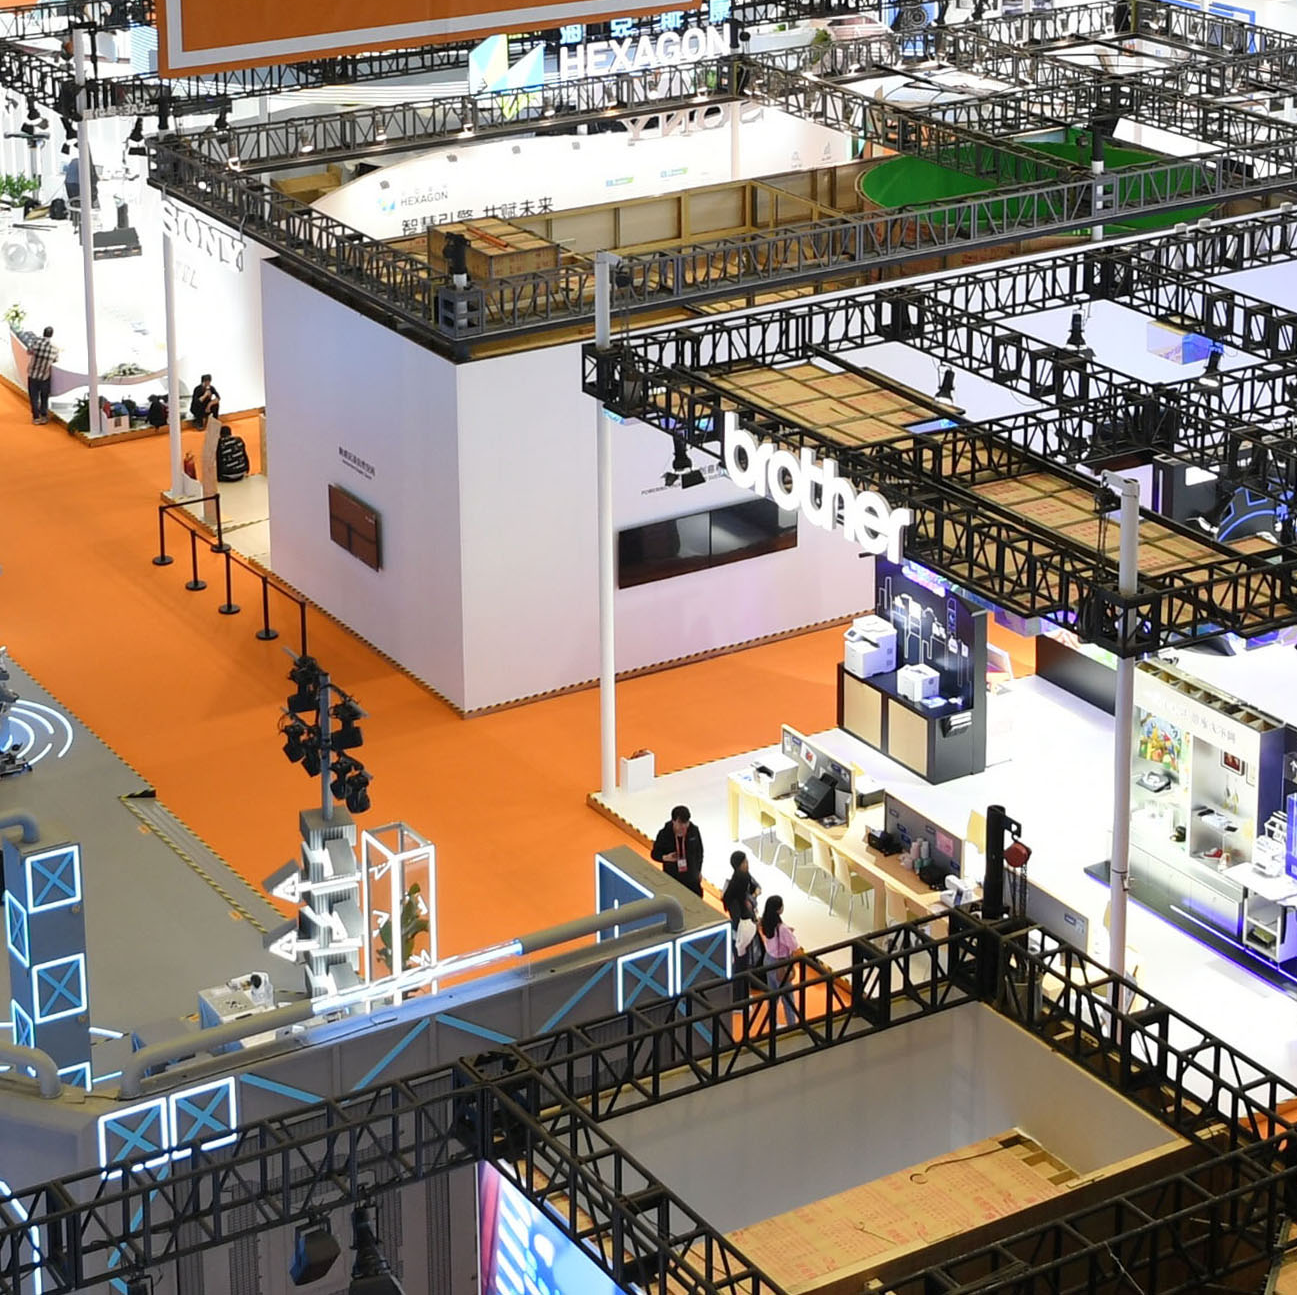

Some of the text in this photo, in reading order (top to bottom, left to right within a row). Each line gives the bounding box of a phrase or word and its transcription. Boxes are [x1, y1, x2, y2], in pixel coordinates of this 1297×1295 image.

[560, 23, 732, 81] HEXAGON
[400, 190, 449, 207] HEXAGON
[162, 204, 247, 272] SONY
[724, 410, 914, 565] brother
